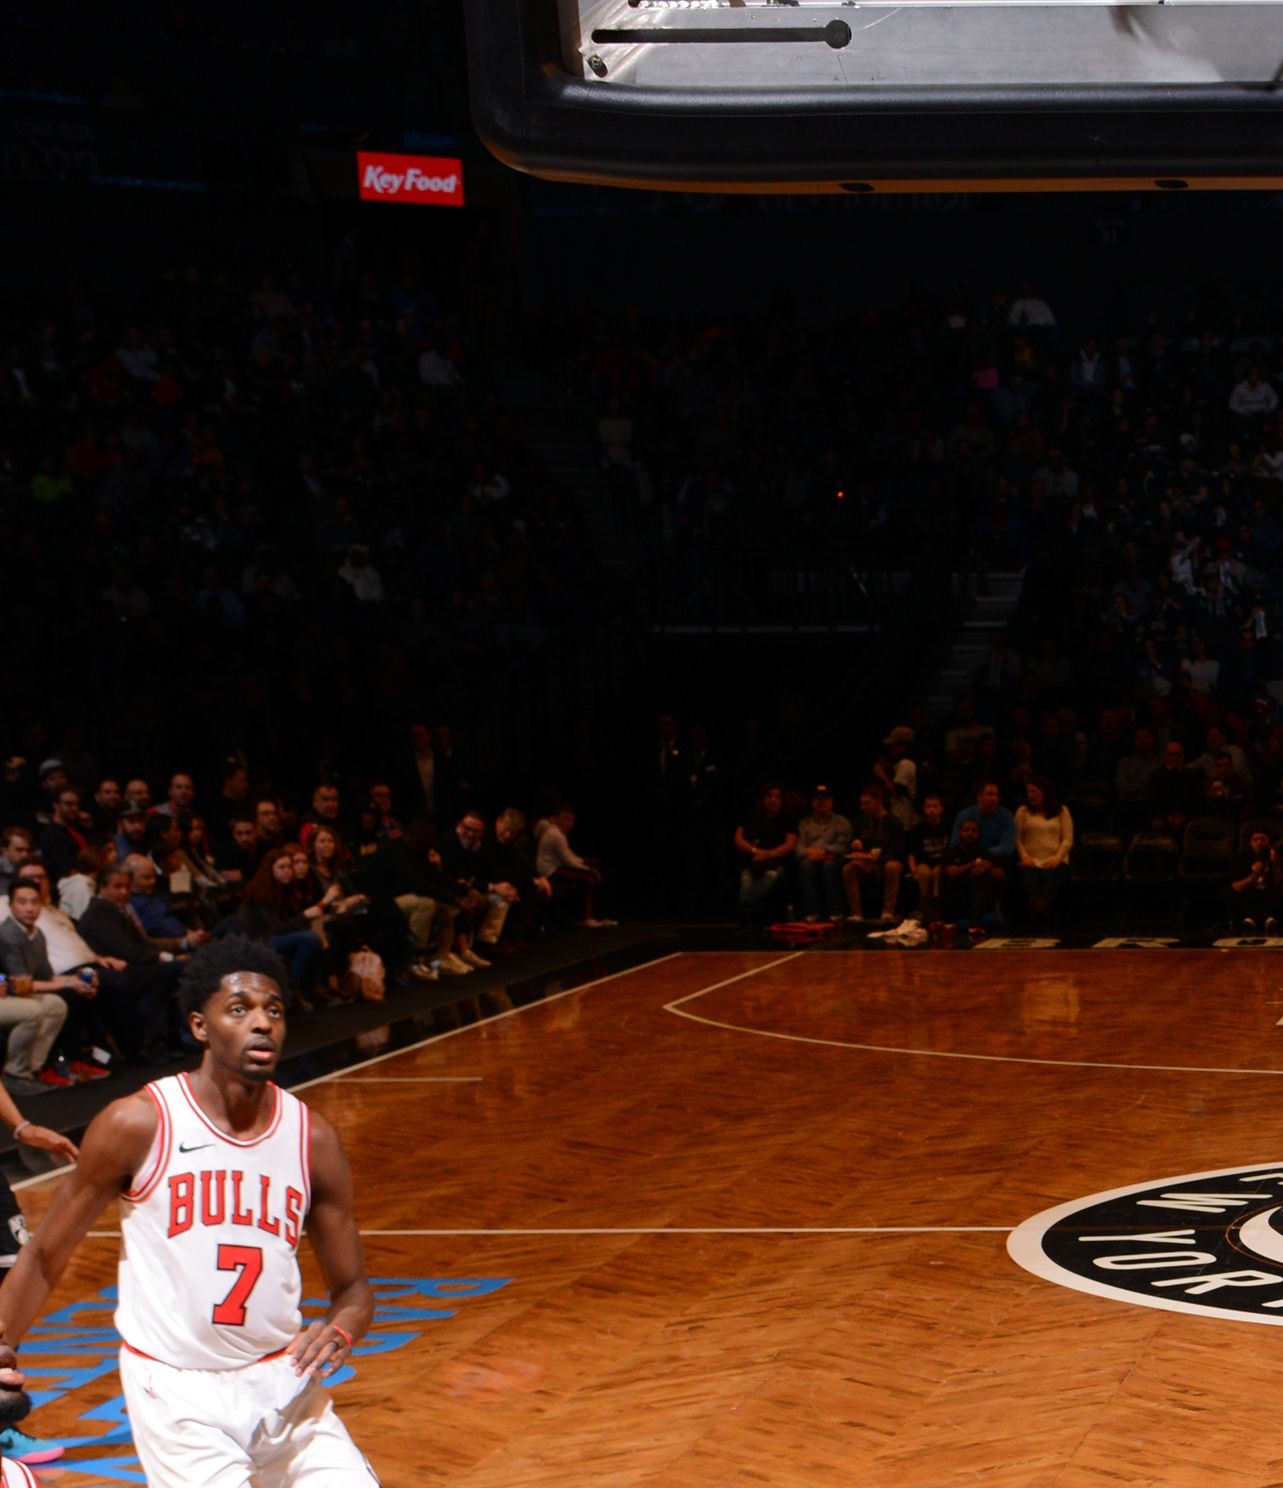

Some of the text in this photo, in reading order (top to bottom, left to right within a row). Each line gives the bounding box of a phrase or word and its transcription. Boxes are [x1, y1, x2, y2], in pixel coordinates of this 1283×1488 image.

[363, 164, 458, 194] Key Food
[168, 1169, 304, 1252] BULLS
[211, 1243, 264, 1327] 7
